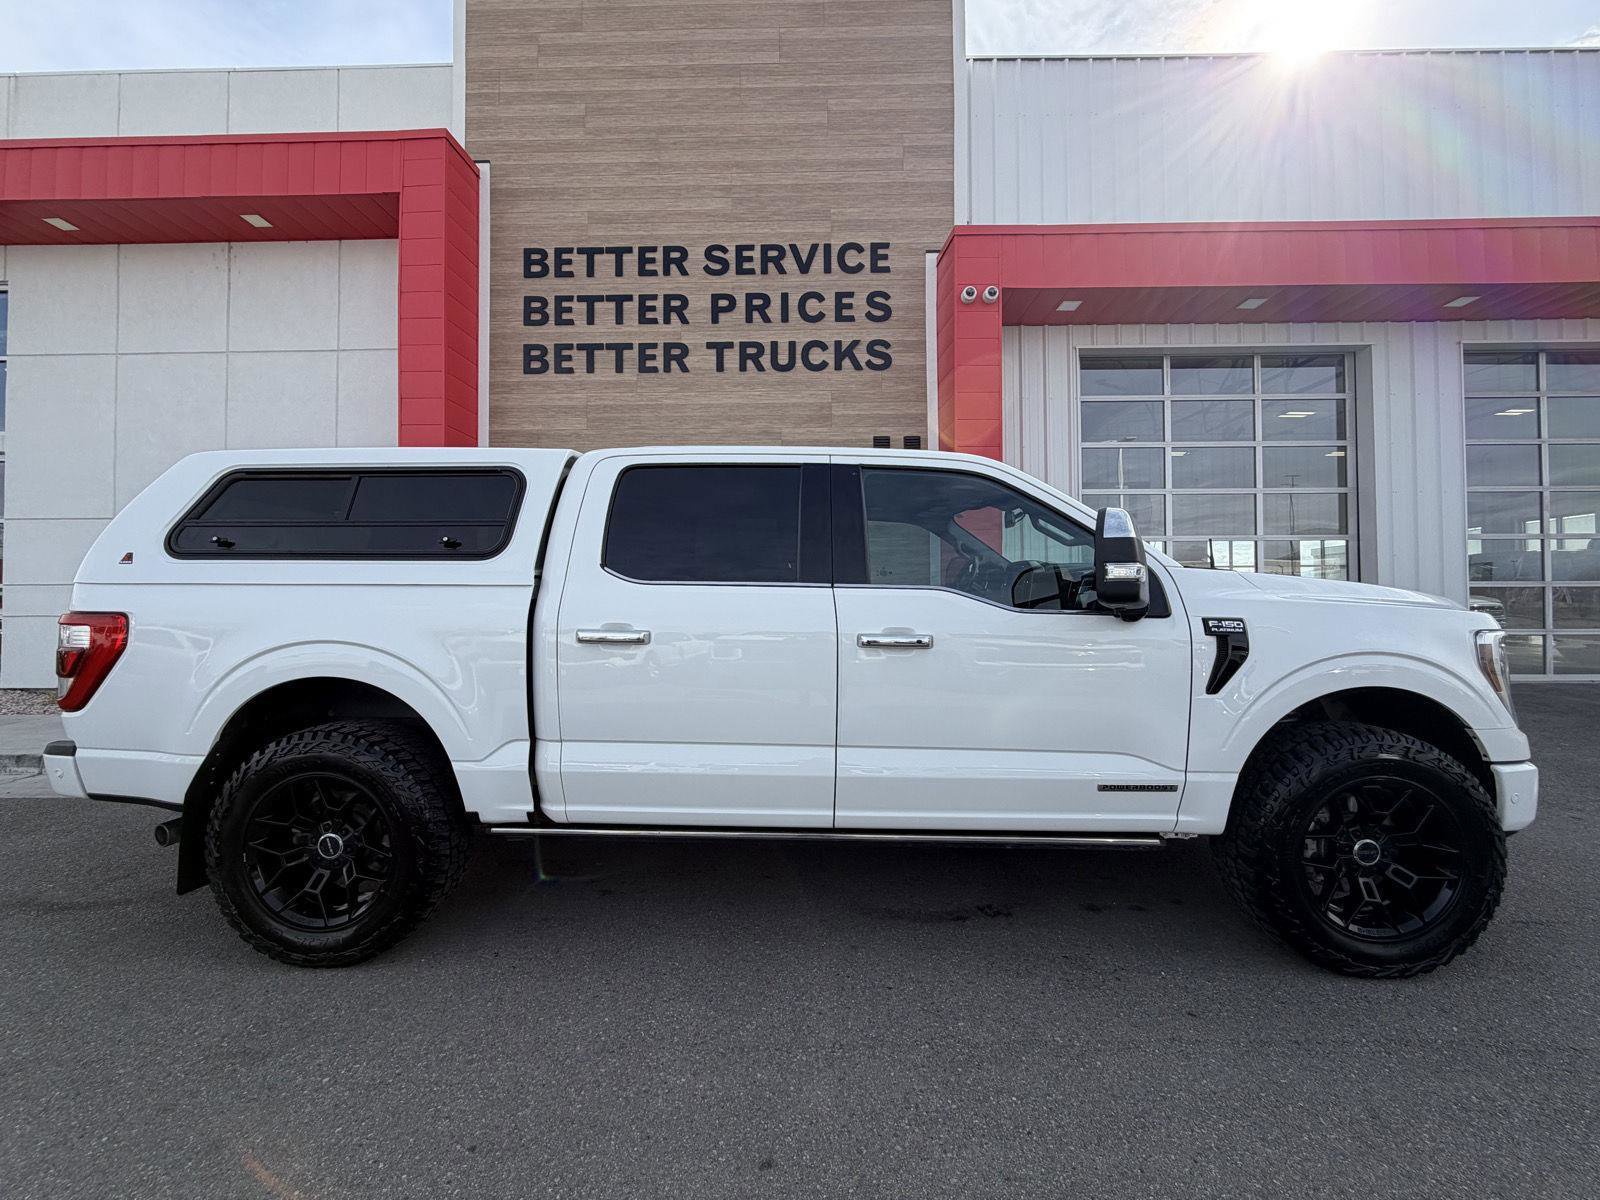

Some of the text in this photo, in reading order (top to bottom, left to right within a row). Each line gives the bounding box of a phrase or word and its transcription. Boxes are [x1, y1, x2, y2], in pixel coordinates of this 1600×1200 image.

[523, 242, 891, 278] BETTER SERVICE
[523, 290, 893, 326] BETTER PRICES
[523, 338, 893, 374] BETTER TRUCKS
[1208, 620, 1244, 628] F-150
